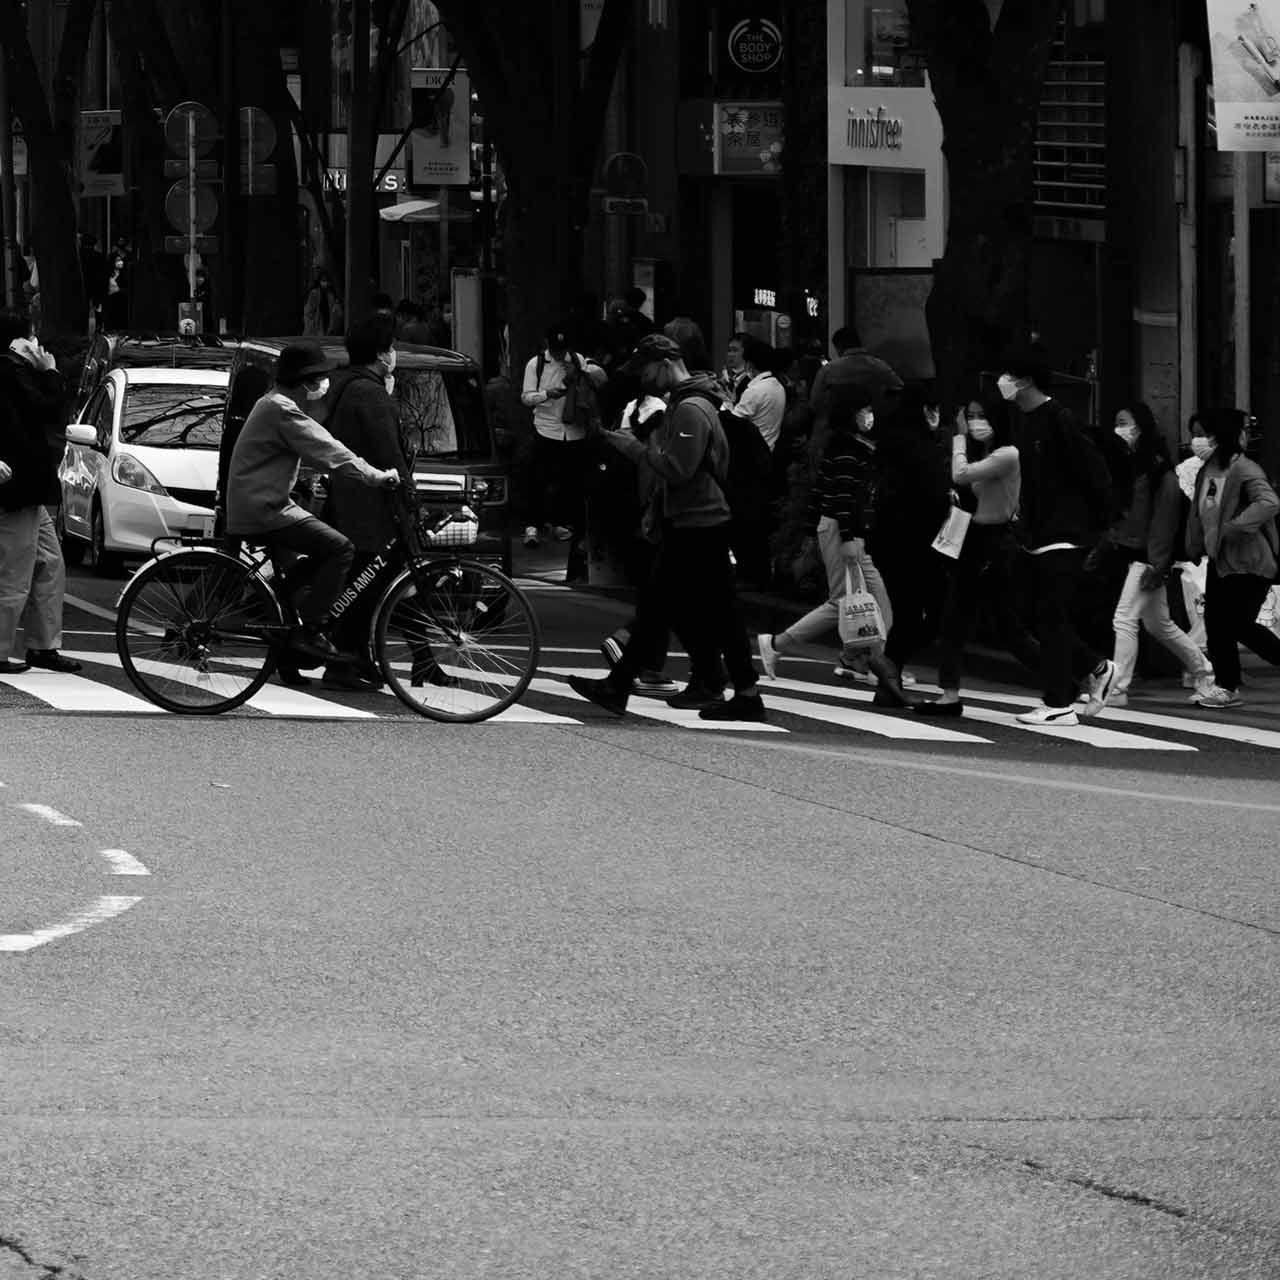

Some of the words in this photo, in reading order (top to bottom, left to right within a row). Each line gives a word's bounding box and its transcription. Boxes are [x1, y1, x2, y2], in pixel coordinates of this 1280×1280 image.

[739, 42, 772, 53] BODY
[741, 53, 772, 64] SHOP
[848, 105, 903, 150] innisfree
